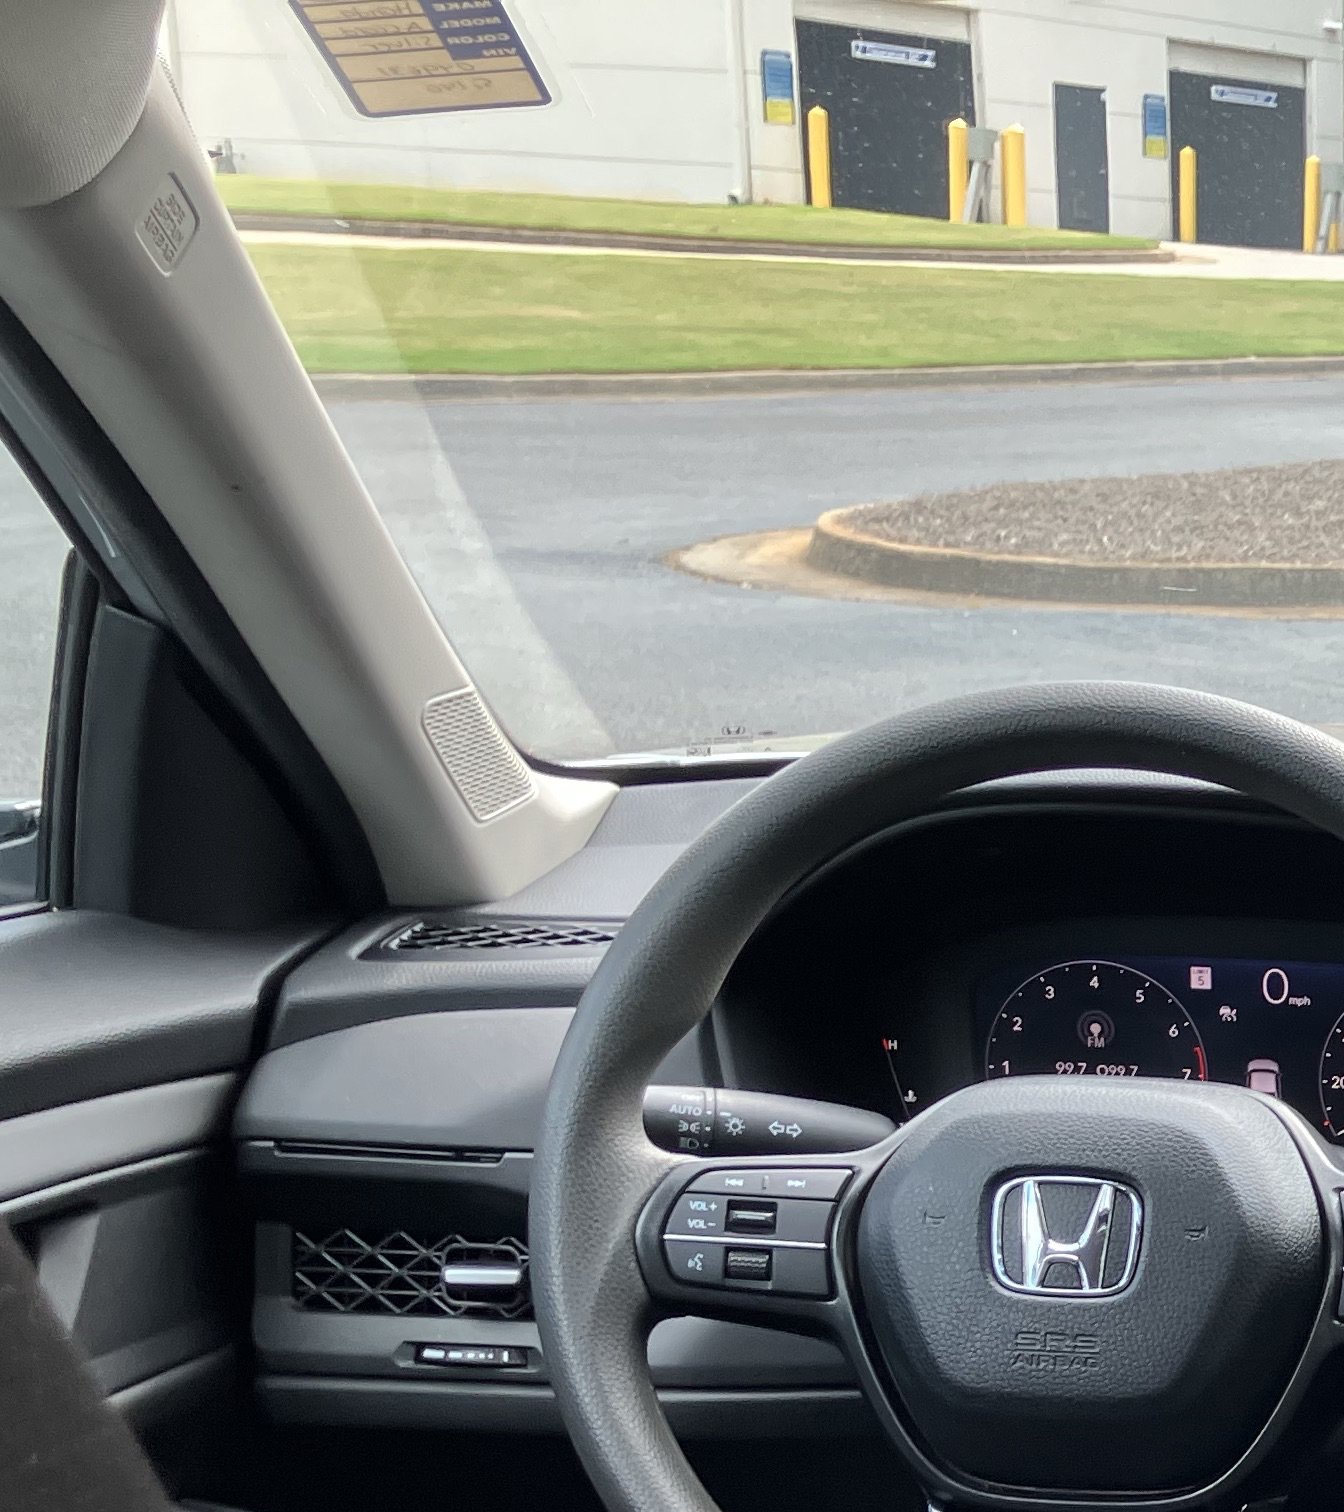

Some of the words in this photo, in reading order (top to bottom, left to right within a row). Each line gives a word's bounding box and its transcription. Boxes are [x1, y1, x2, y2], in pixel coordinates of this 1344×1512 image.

[1089, 976, 1100, 989] 4
[1197, 975, 1205, 987] 5
[1262, 968, 1290, 1004] 0
[1288, 995, 1312, 1007] mph
[1045, 986, 1055, 1000] 3
[1135, 990, 1146, 1003] 5
[1012, 1017, 1023, 1032] 2
[1168, 1024, 1179, 1038] 6
[888, 1039, 898, 1050] H
[1087, 1037, 1105, 1048] FM
[1002, 1061, 1011, 1075] 1
[1055, 1062, 1088, 1076] 99.7
[669, 1104, 702, 1116] AUTO
[1014, 1331, 1100, 1350] SRS
[1010, 1353, 1100, 1370] AIRBAG
